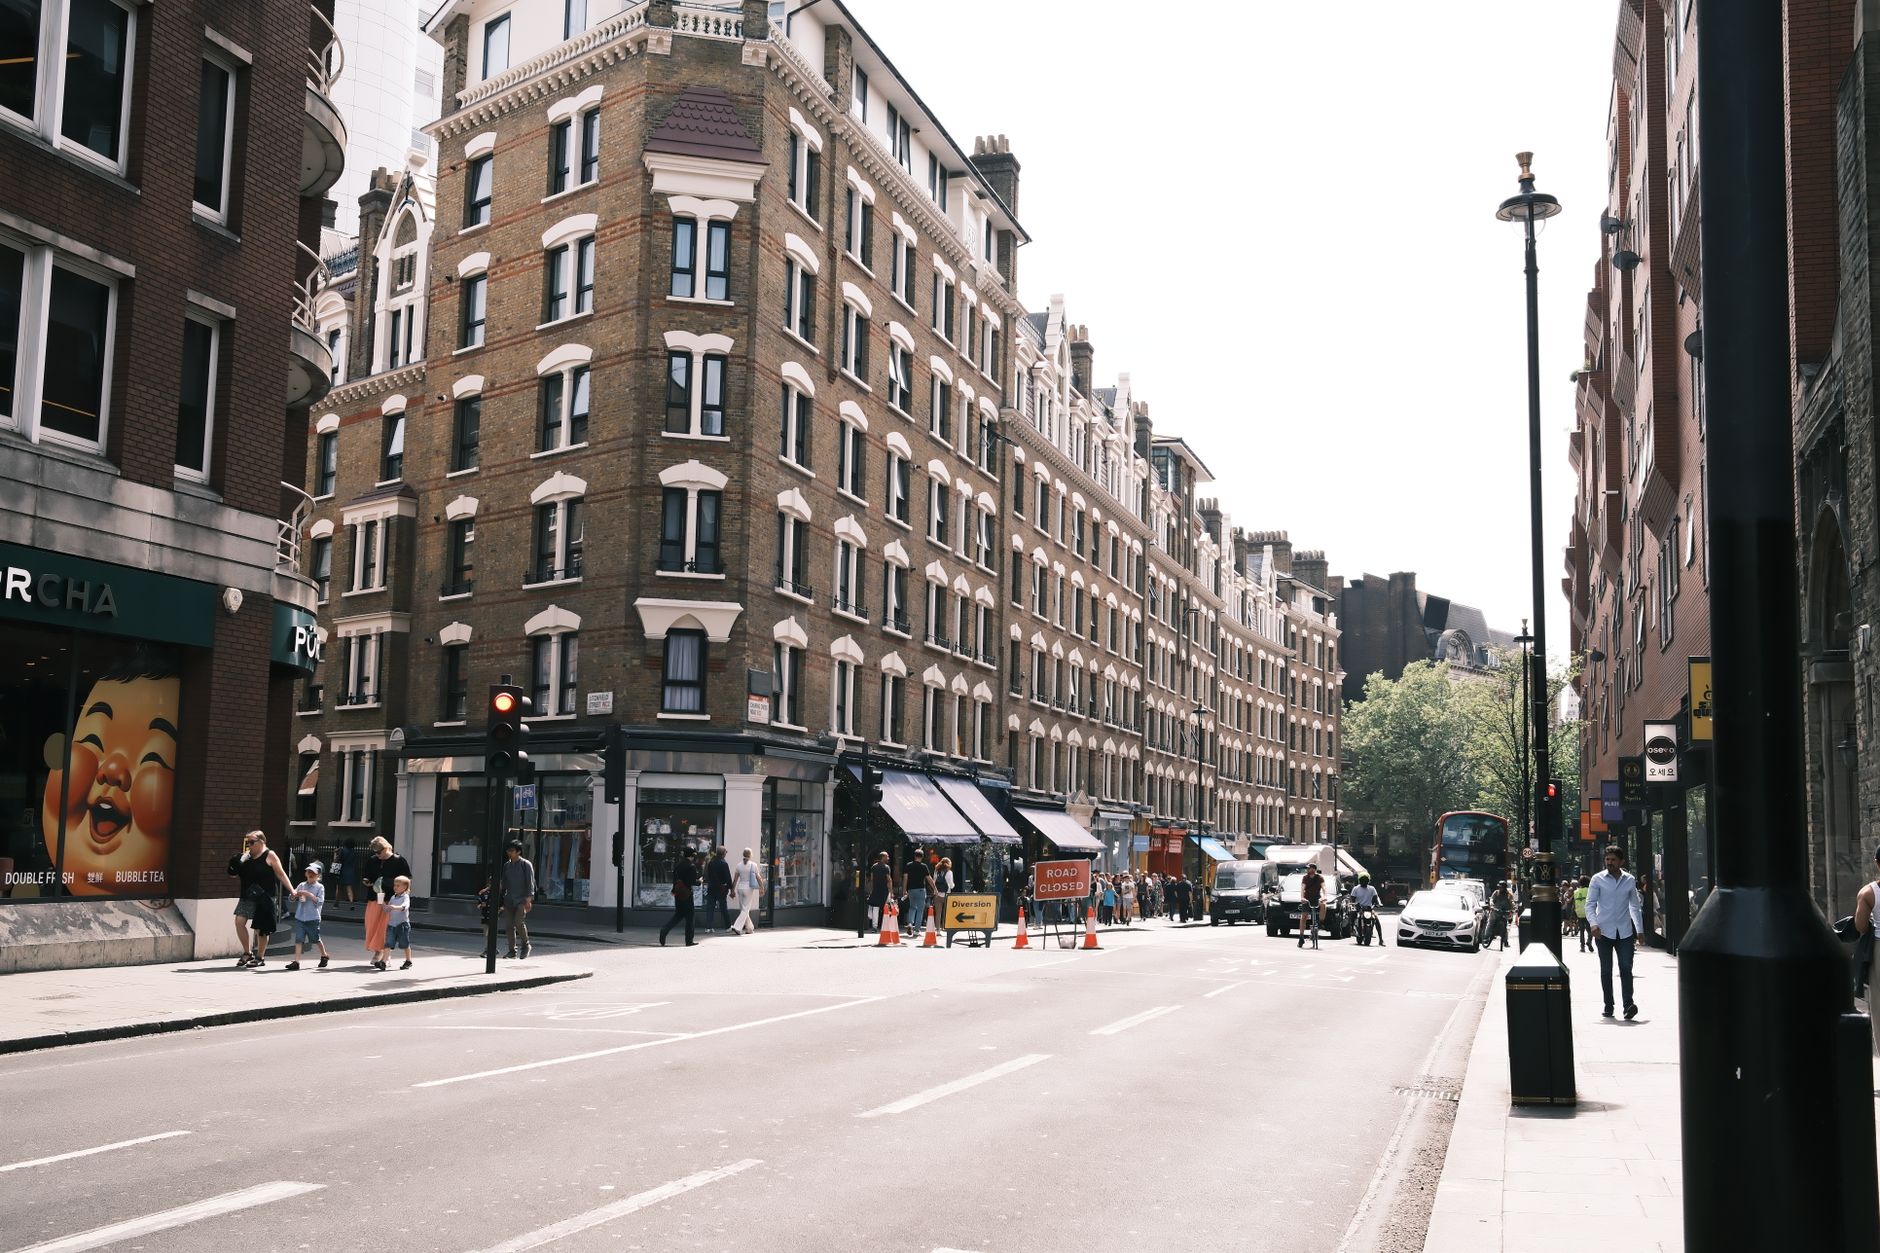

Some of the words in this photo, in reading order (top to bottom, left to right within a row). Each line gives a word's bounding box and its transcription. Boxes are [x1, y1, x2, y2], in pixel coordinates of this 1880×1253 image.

[0, 566, 118, 617] RCHA
[1649, 768, 1675, 776] 오세요
[5, 872, 44, 884] DOUBLE
[46, 871, 74, 884] FRSH
[115, 870, 147, 883] BUBBLE
[149, 871, 164, 882] TEA
[1046, 867, 1078, 878] ROAD
[1040, 881, 1084, 893] CLOSED
[951, 900, 992, 908] Diversion
